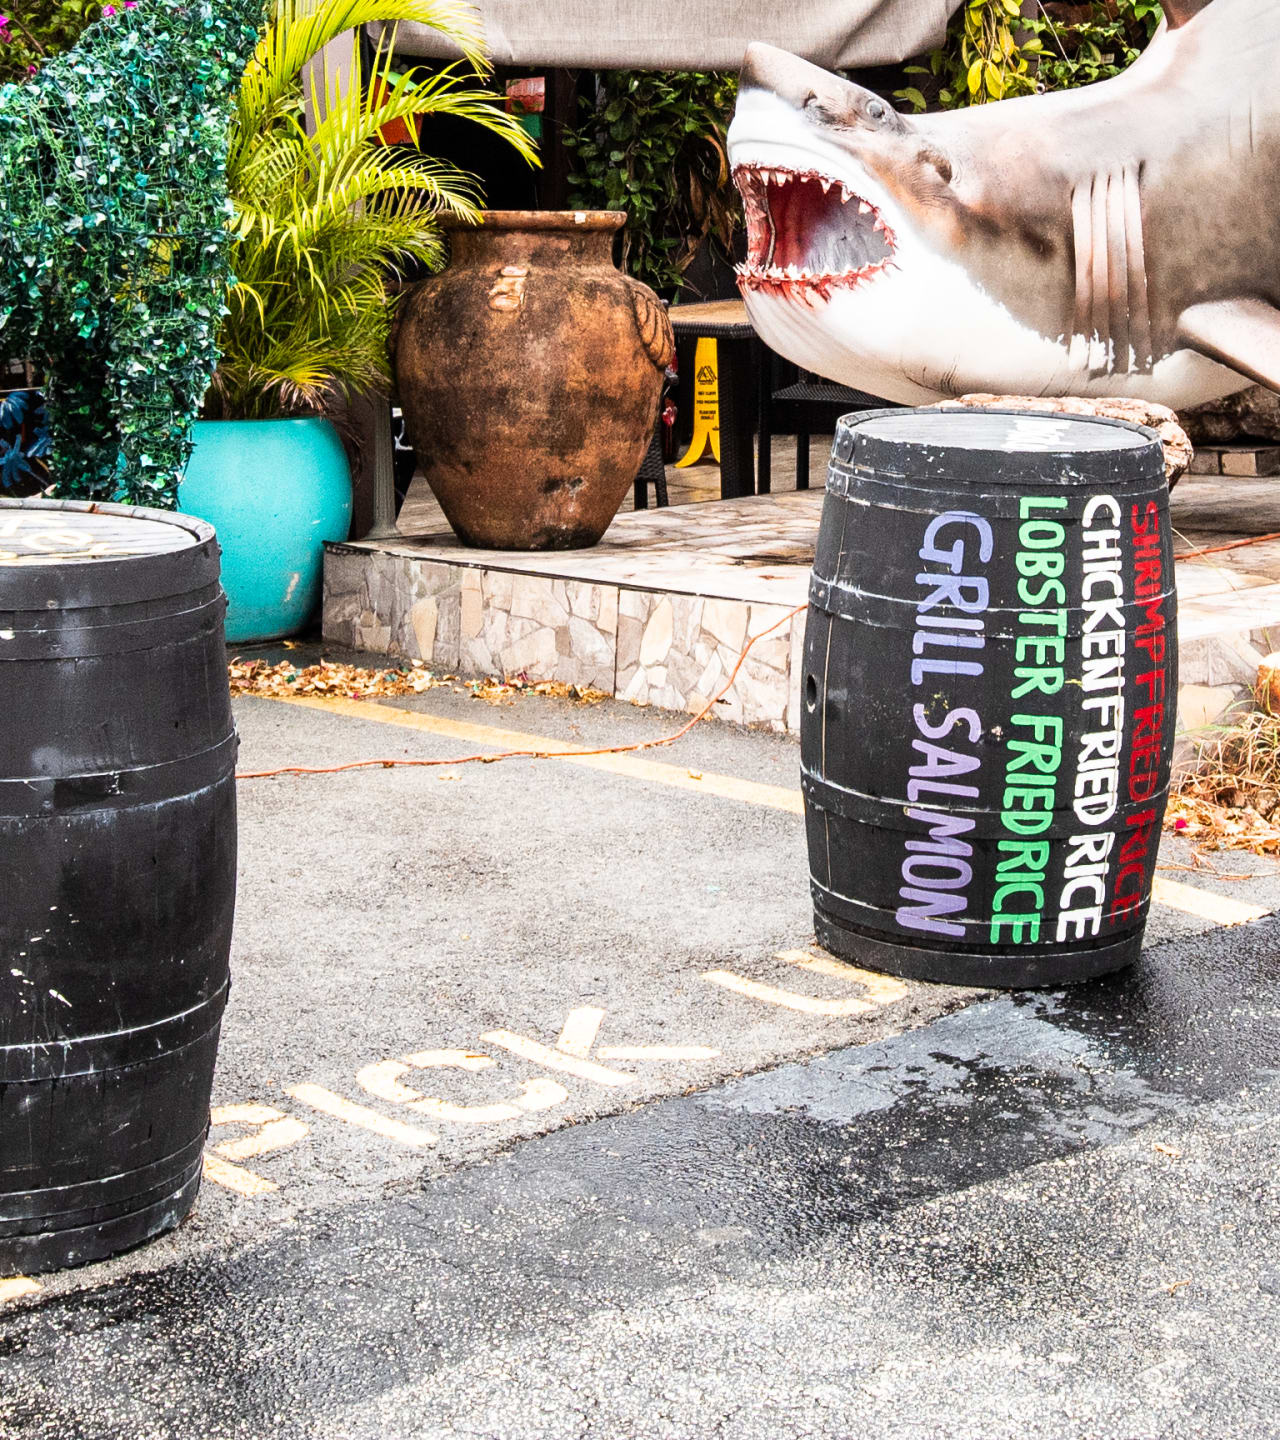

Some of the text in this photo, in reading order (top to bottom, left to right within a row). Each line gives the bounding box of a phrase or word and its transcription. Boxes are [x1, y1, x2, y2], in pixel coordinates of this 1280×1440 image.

[894, 510, 995, 938] GRILL SALMON
[989, 495, 1069, 945] LOBSTER FRIED RICE
[1056, 831, 1116, 943] RICE
[1072, 695, 1126, 826] FRIED
[1109, 500, 1167, 927] SHRIMP FRIED RICE
